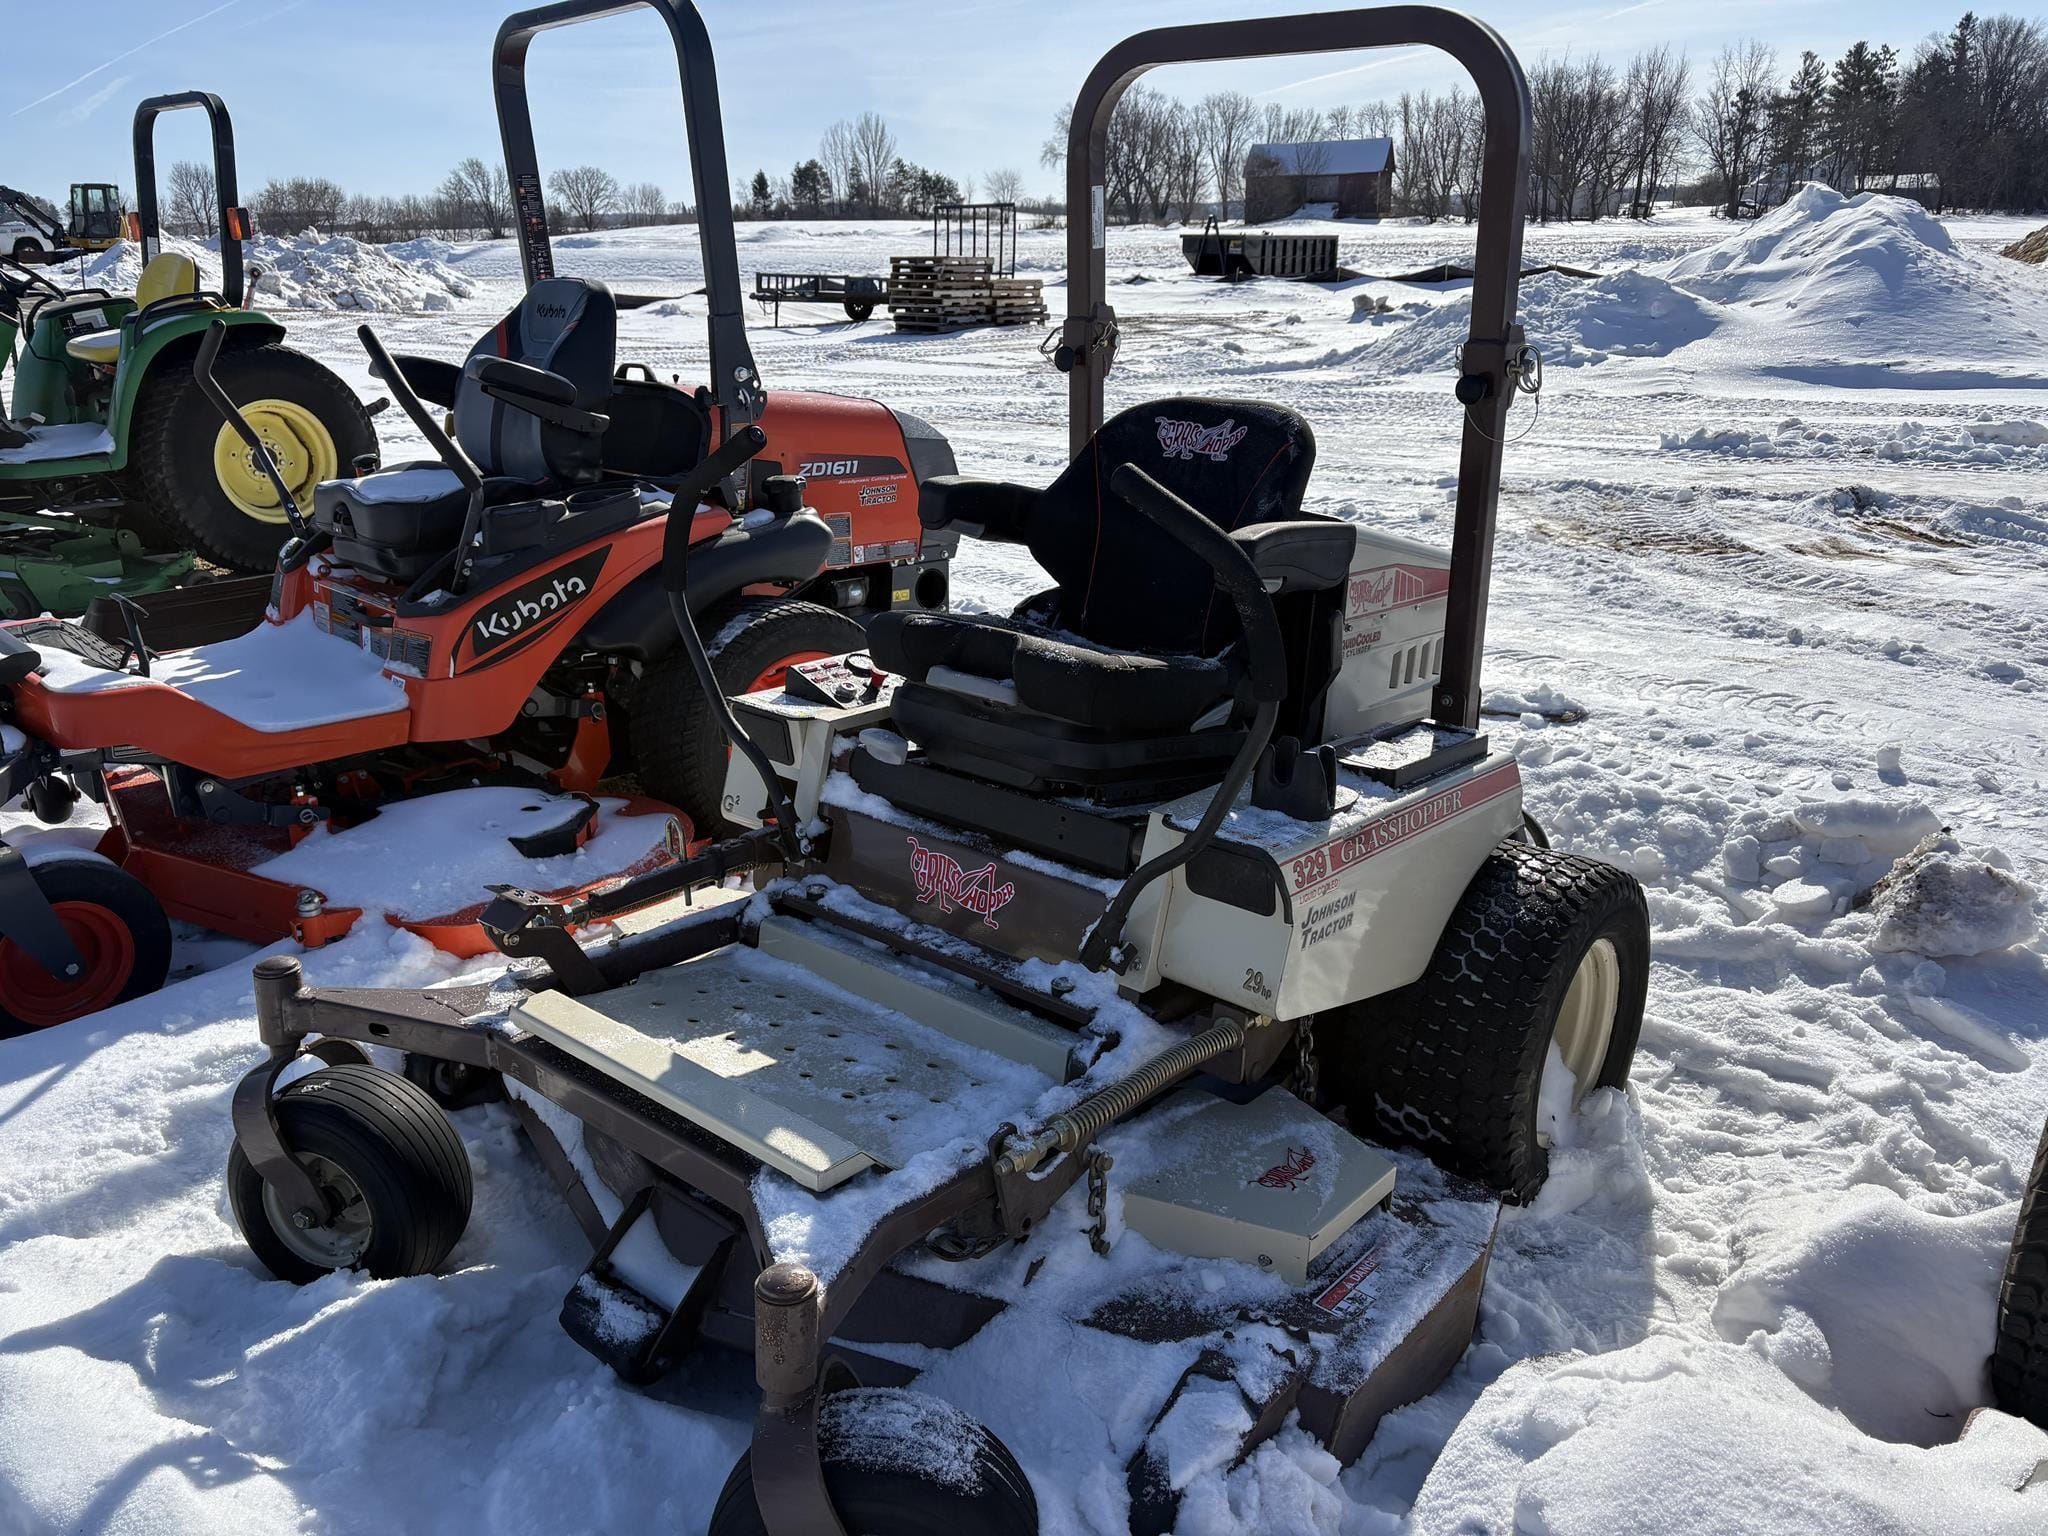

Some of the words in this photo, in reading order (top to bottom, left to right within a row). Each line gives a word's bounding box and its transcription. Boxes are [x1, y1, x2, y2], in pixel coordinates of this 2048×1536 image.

[536, 303, 566, 319] Kubota
[799, 460, 858, 477] ZD1611
[859, 484, 897, 496] JOHNSON
[860, 495, 897, 506] TRACTOR
[476, 576, 587, 639] Kubota
[1341, 790, 1463, 862] GRASSHOPPER
[1293, 850, 1327, 889] 329
[1301, 890, 1357, 930] JOHNSON
[1301, 911, 1354, 951] TRACTOR
